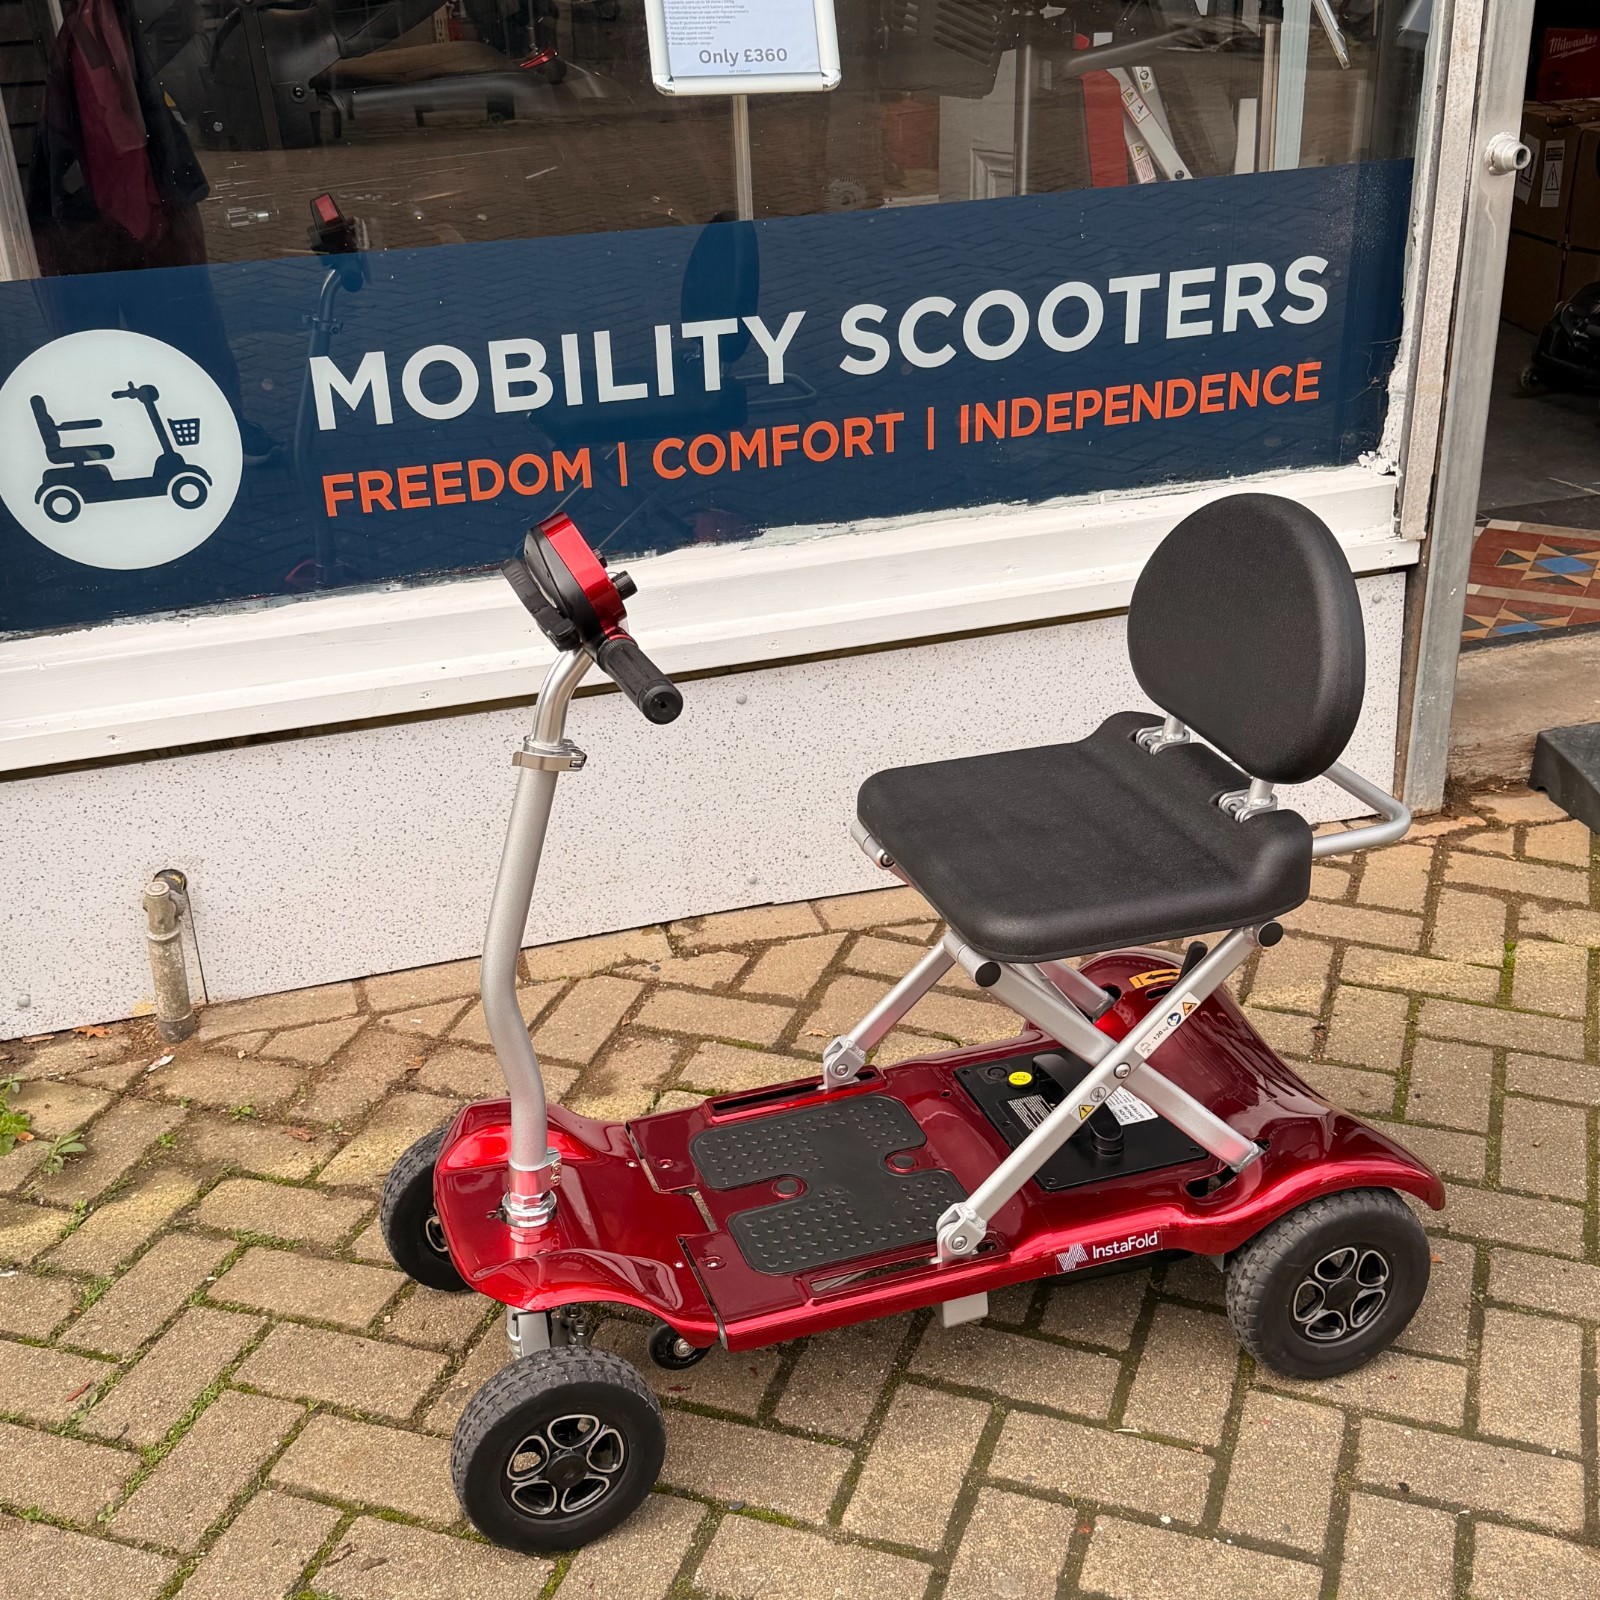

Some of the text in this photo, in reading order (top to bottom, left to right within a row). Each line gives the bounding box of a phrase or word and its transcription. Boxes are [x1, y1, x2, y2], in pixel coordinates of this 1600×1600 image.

[699, 47, 788, 67] Only £360
[1549, 33, 1598, 54] Milwaukee
[309, 255, 1329, 431] MOBILITY SCOOTERS
[323, 448, 592, 517] FREEDOM
[653, 412, 904, 479] COMFORT
[960, 362, 1321, 444] INDEPENDENCE
[1092, 1231, 1158, 1259] InstaFold
